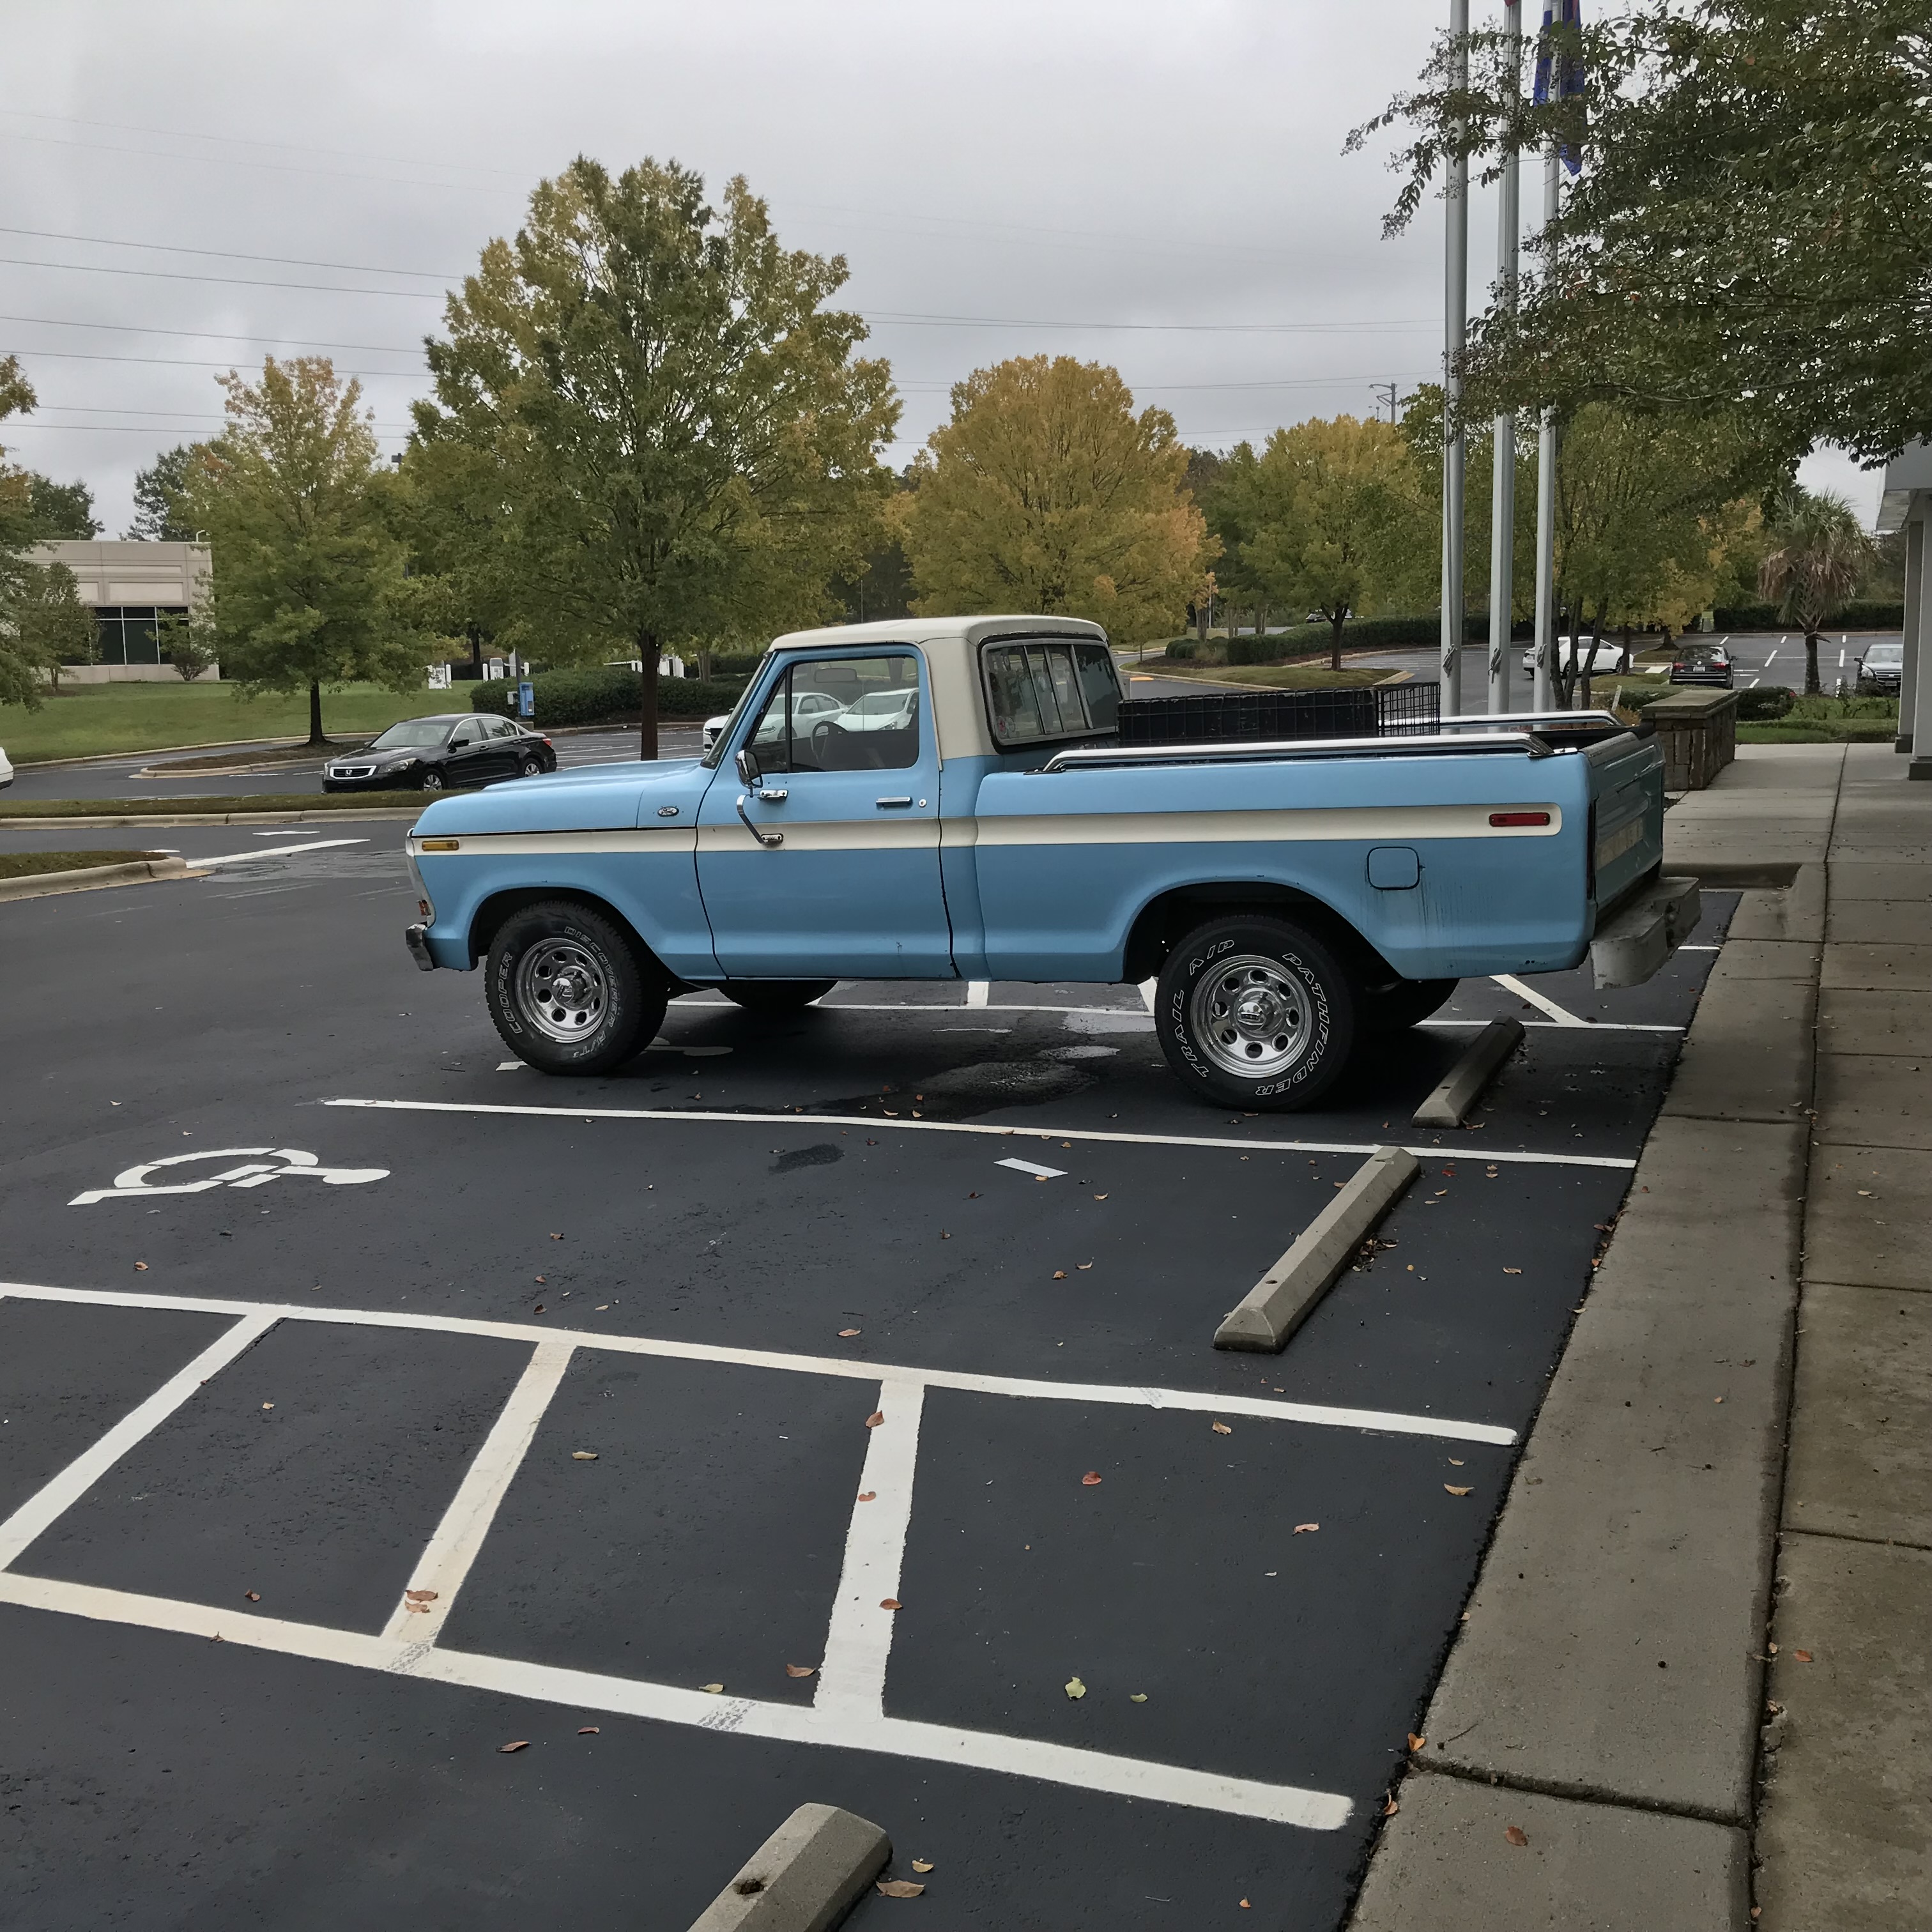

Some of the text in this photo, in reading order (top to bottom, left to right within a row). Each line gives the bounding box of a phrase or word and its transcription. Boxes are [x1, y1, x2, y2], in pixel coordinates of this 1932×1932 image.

[497, 951, 523, 1034] COOPER
[564, 926, 619, 1027] DISCOVERER
[1172, 990, 1209, 1078] TRAIL
[1255, 953, 1330, 1096] PATHFINDER
